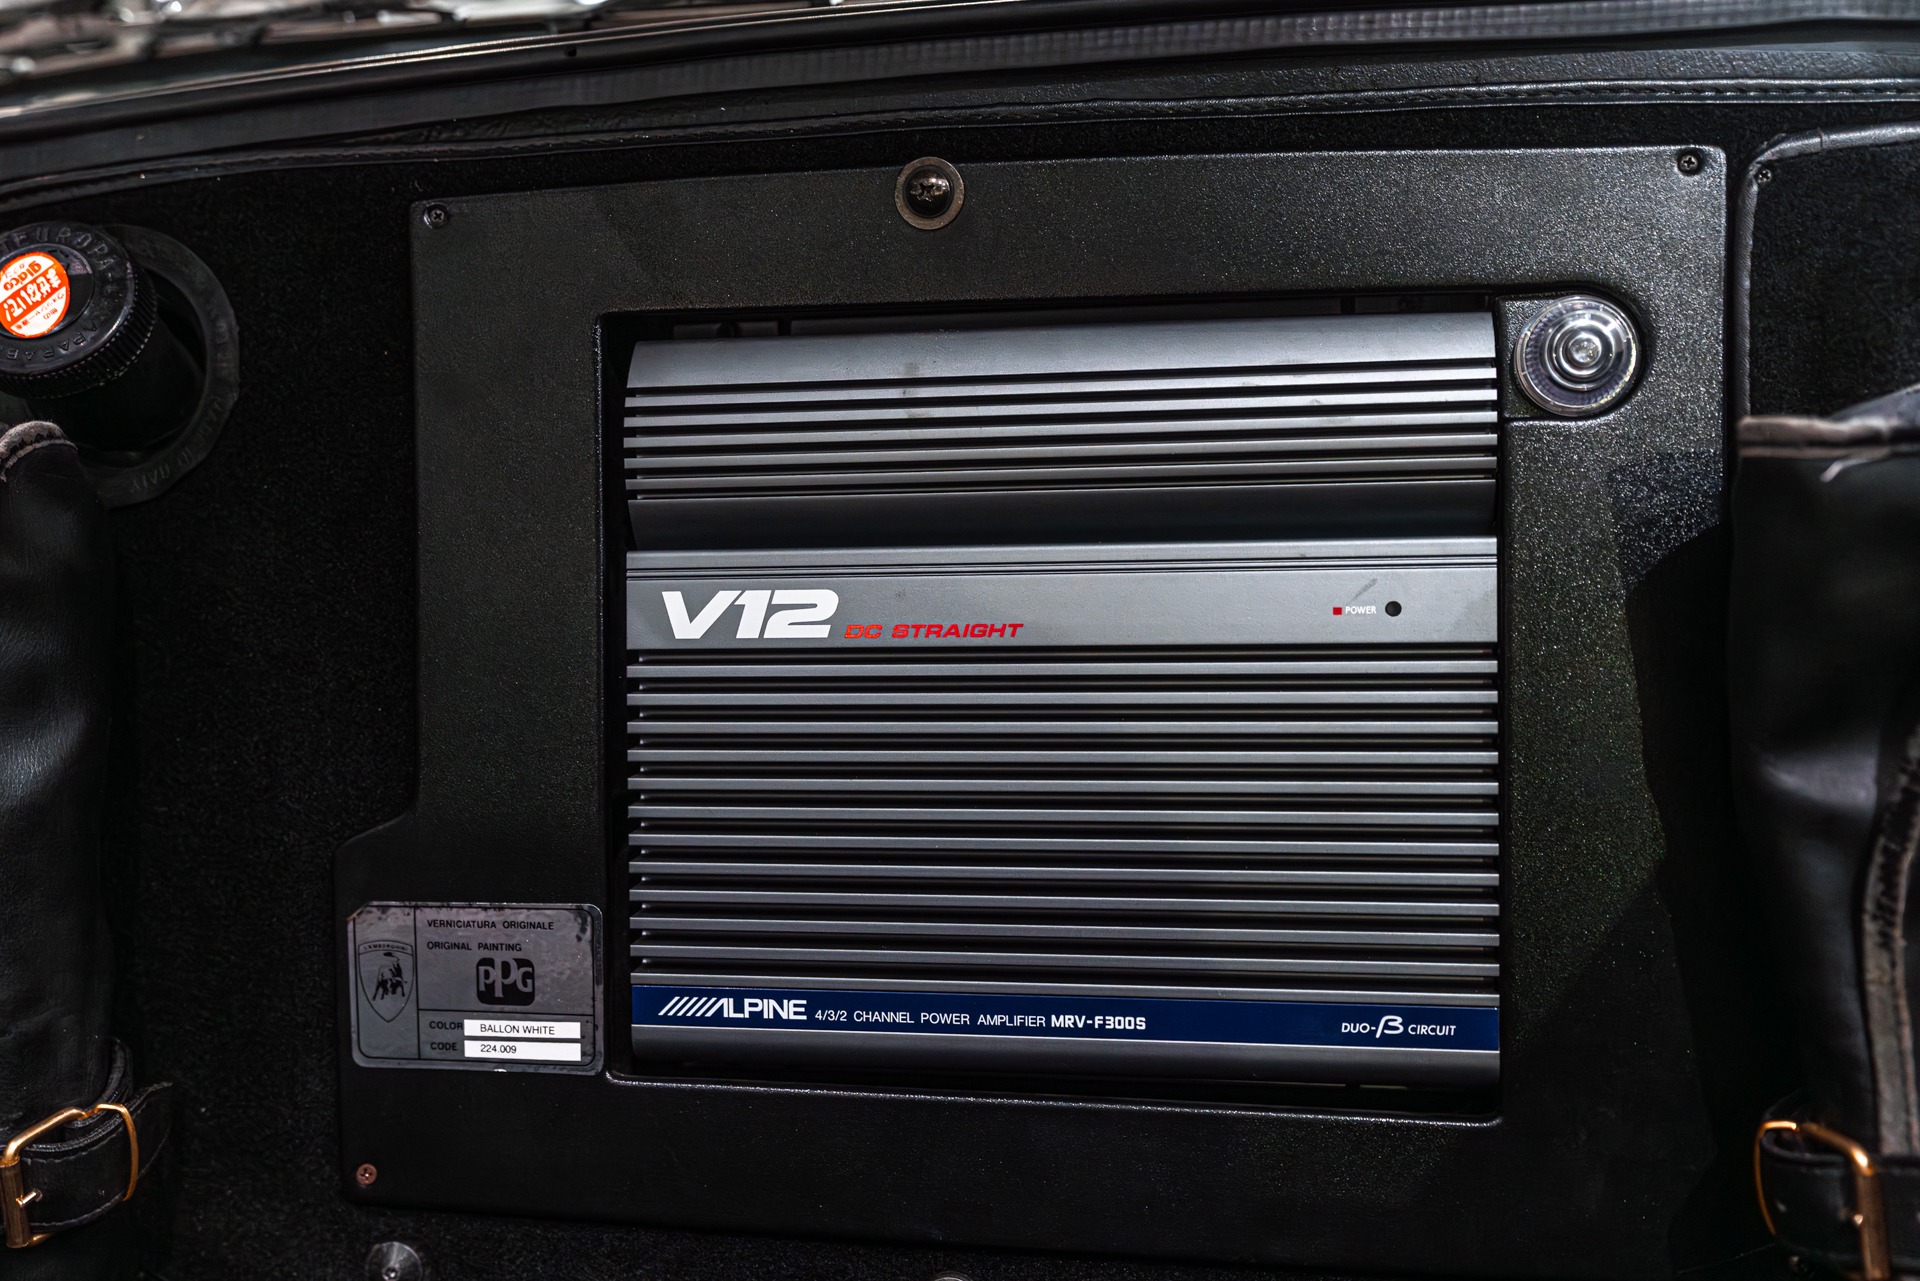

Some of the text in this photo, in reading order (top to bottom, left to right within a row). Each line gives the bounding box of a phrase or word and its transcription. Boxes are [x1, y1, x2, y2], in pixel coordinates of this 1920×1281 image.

[661, 588, 839, 639] V12
[1345, 605, 1377, 614] POWER
[844, 622, 1024, 639] DC STRAIGHT
[427, 919, 555, 931] VERNICIATURA ORIGINALE
[427, 941, 523, 952] ORIGINAL PAINTING
[477, 956, 535, 999] PPG
[704, 997, 807, 1020] ALPINE
[429, 1020, 463, 1030] COLOR
[815, 1009, 1146, 1030] 4/3/2 CHANNEL POWER AMPLIFIER MRV-F300S
[480, 1023, 555, 1035] BALLON WHITE
[1408, 1024, 1457, 1036] CIRCUIT
[430, 1041, 458, 1051] CODE
[480, 1043, 517, 1054] 224.009
